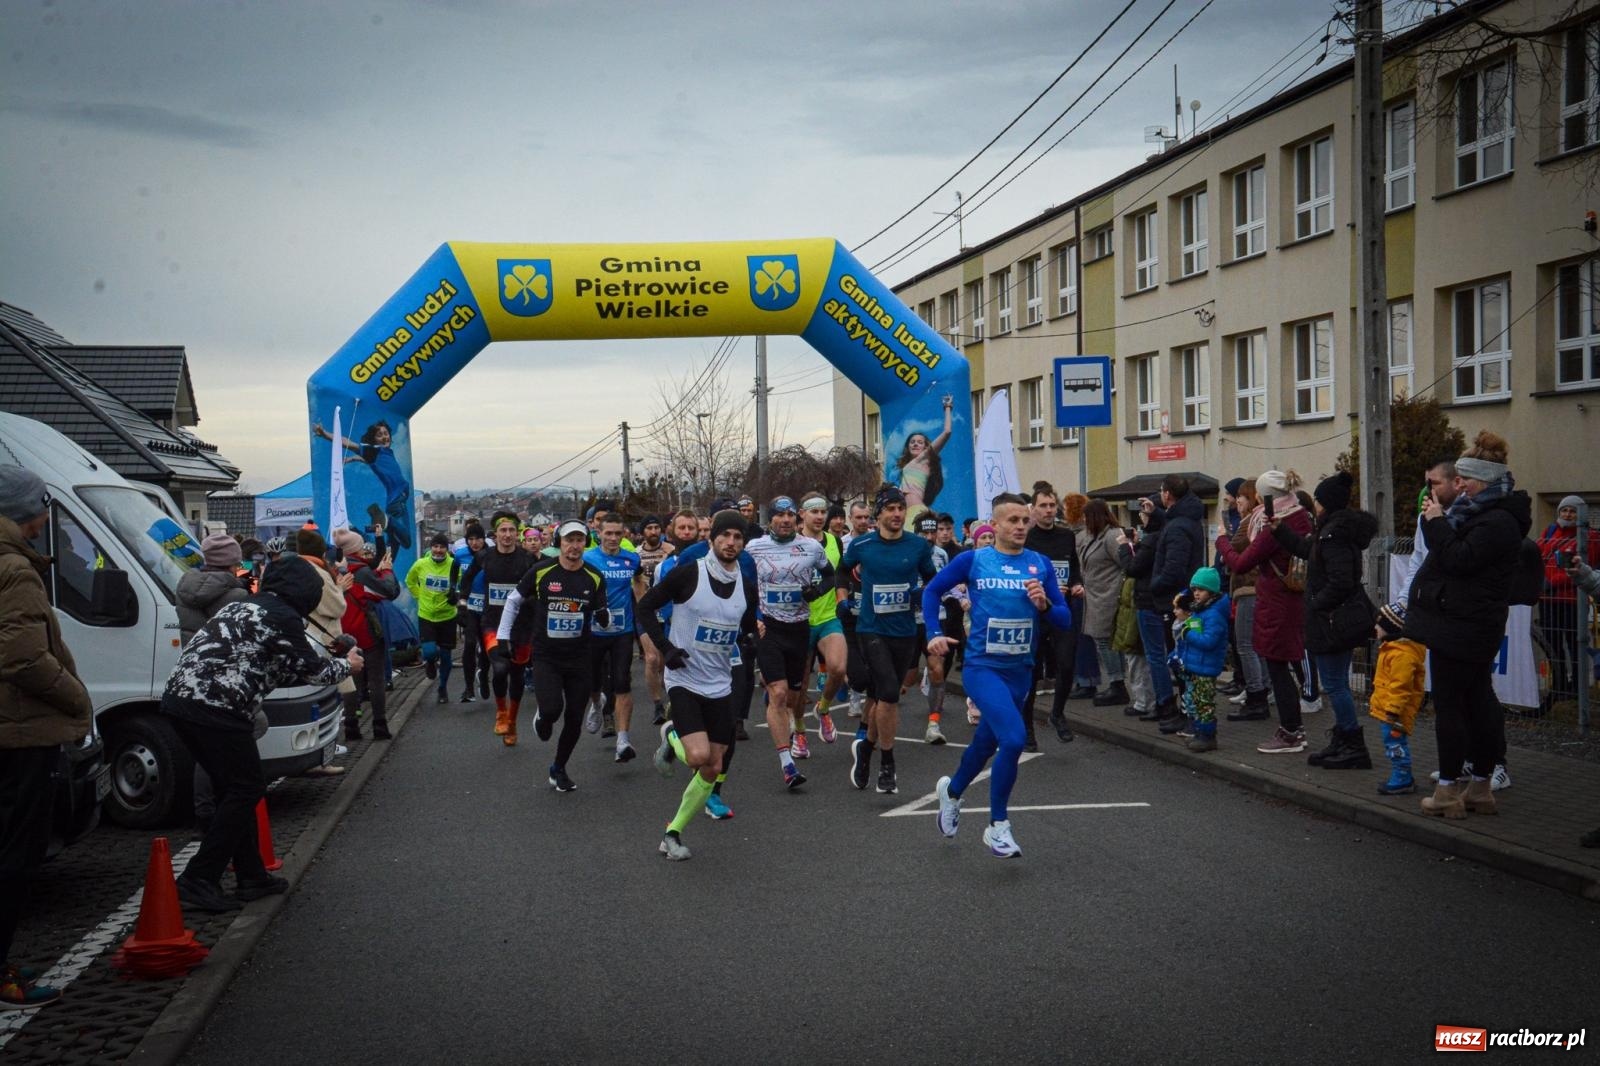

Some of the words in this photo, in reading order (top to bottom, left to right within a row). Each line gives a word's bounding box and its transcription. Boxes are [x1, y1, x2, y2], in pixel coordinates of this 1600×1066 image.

[600, 257, 701, 273] Gmina
[575, 277, 729, 298] Pietrowice
[596, 299, 709, 320] Wielkie
[839, 274, 893, 330] Gmina
[892, 322, 942, 369] ludzi
[350, 327, 412, 384] Gmina
[405, 279, 458, 331] ludzi
[823, 298, 921, 388] aktywnych
[376, 304, 476, 403] aktywnych
[1054, 567, 1066, 578] 20
[431, 578, 443, 587] 71
[776, 591, 793, 603] 16
[878, 591, 905, 605] 218
[554, 619, 577, 631] 155
[703, 628, 732, 645] 134
[997, 628, 1026, 644] 114
